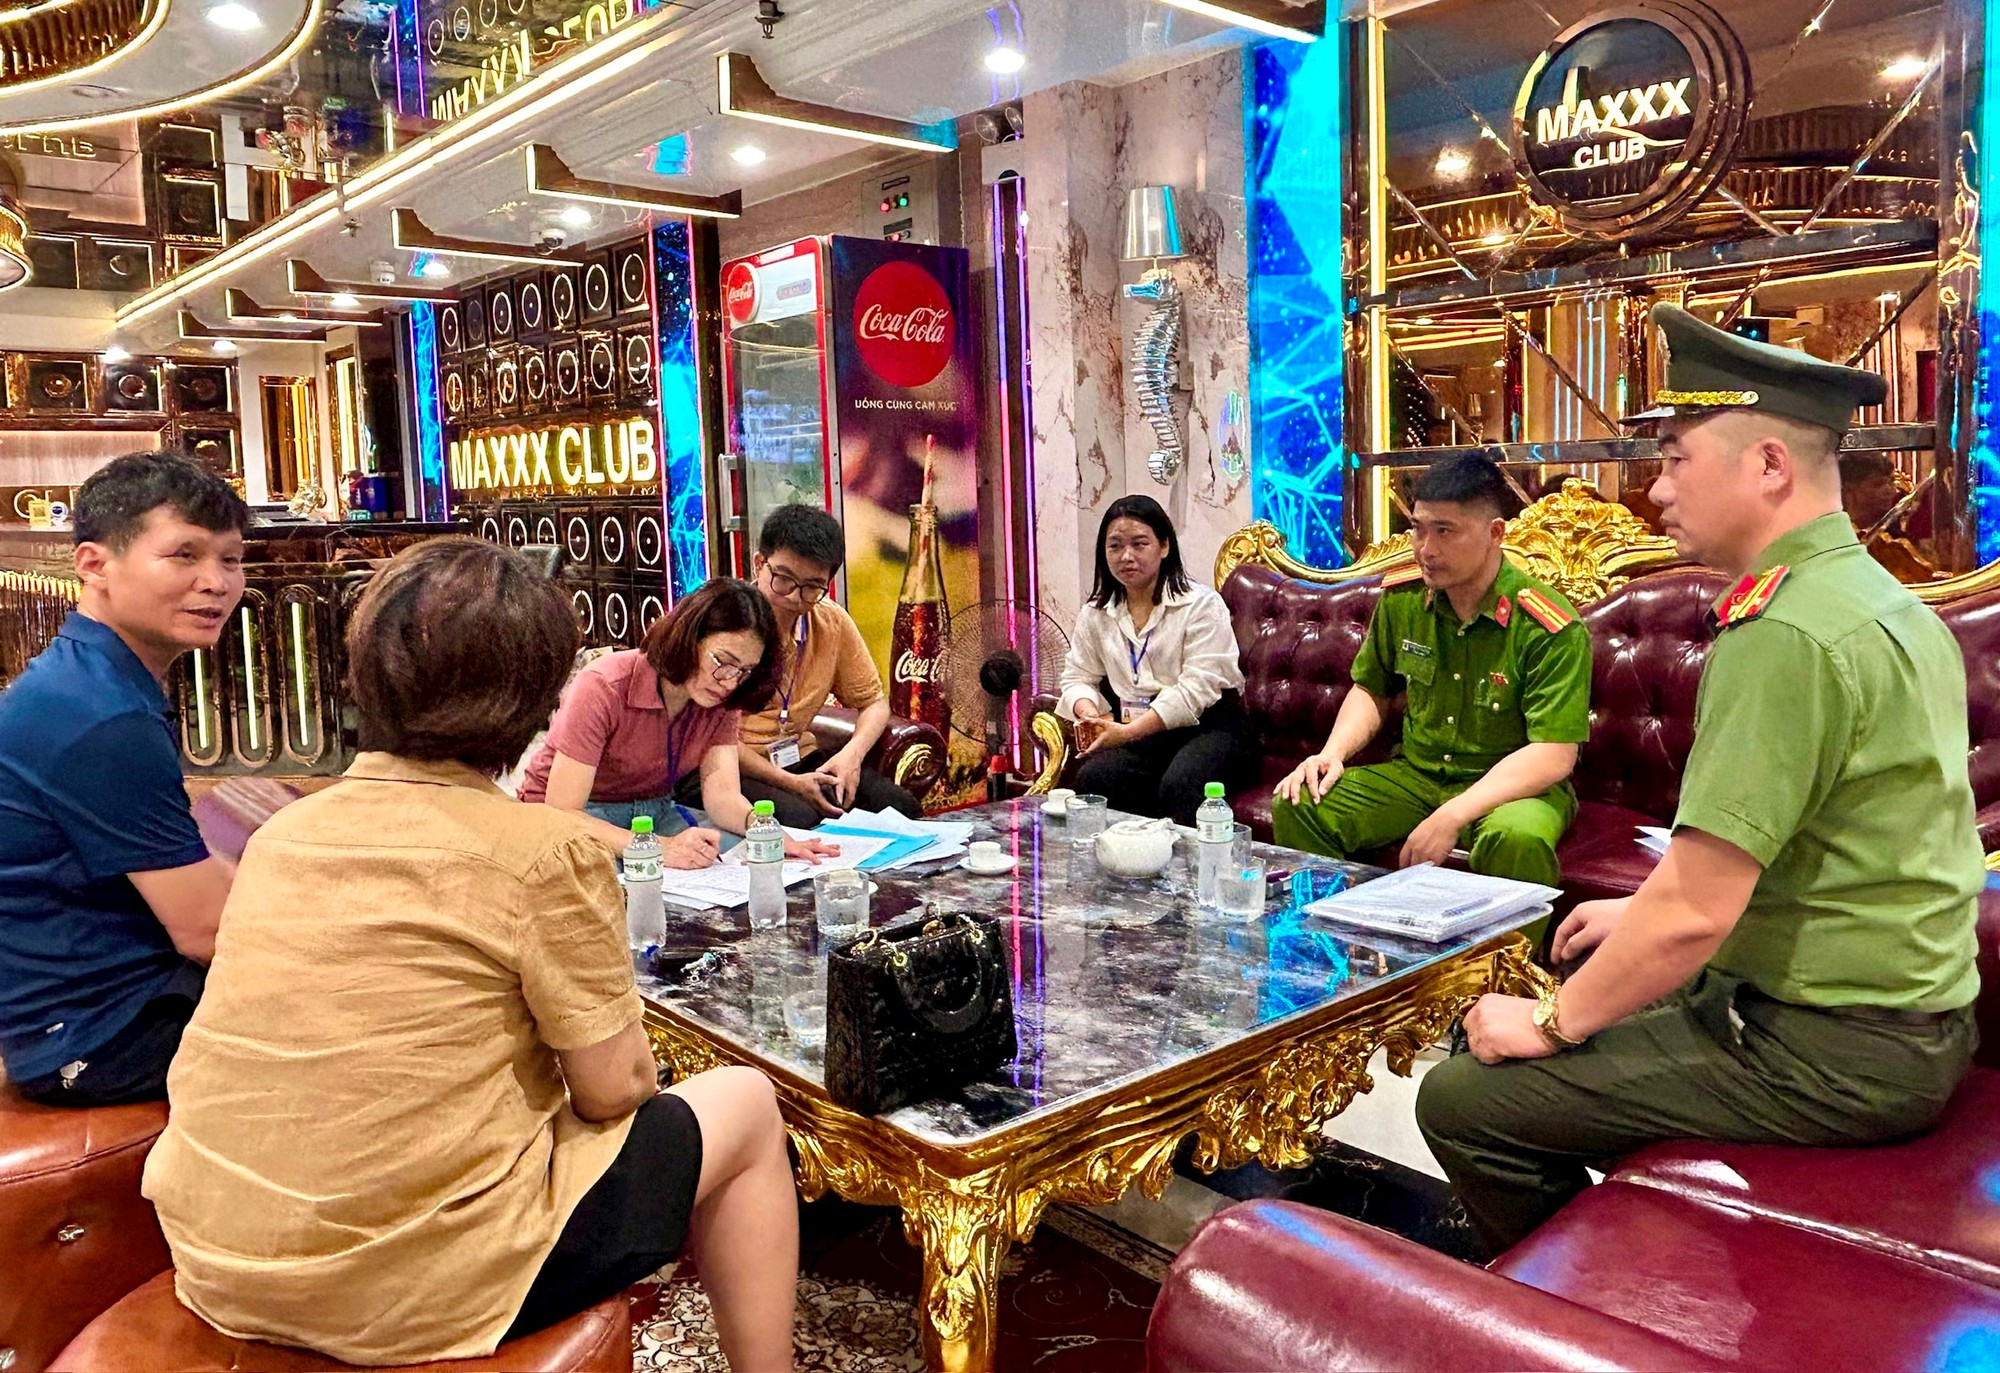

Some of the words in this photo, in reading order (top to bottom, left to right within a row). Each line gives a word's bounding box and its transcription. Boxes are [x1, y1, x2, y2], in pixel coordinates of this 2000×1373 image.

[1536, 77, 1691, 145] MAXXX
[1573, 136, 1648, 169] CLUB
[859, 303, 949, 344] Coca-Cola
[449, 430, 552, 490] MAXXX
[558, 420, 657, 485] CLUB
